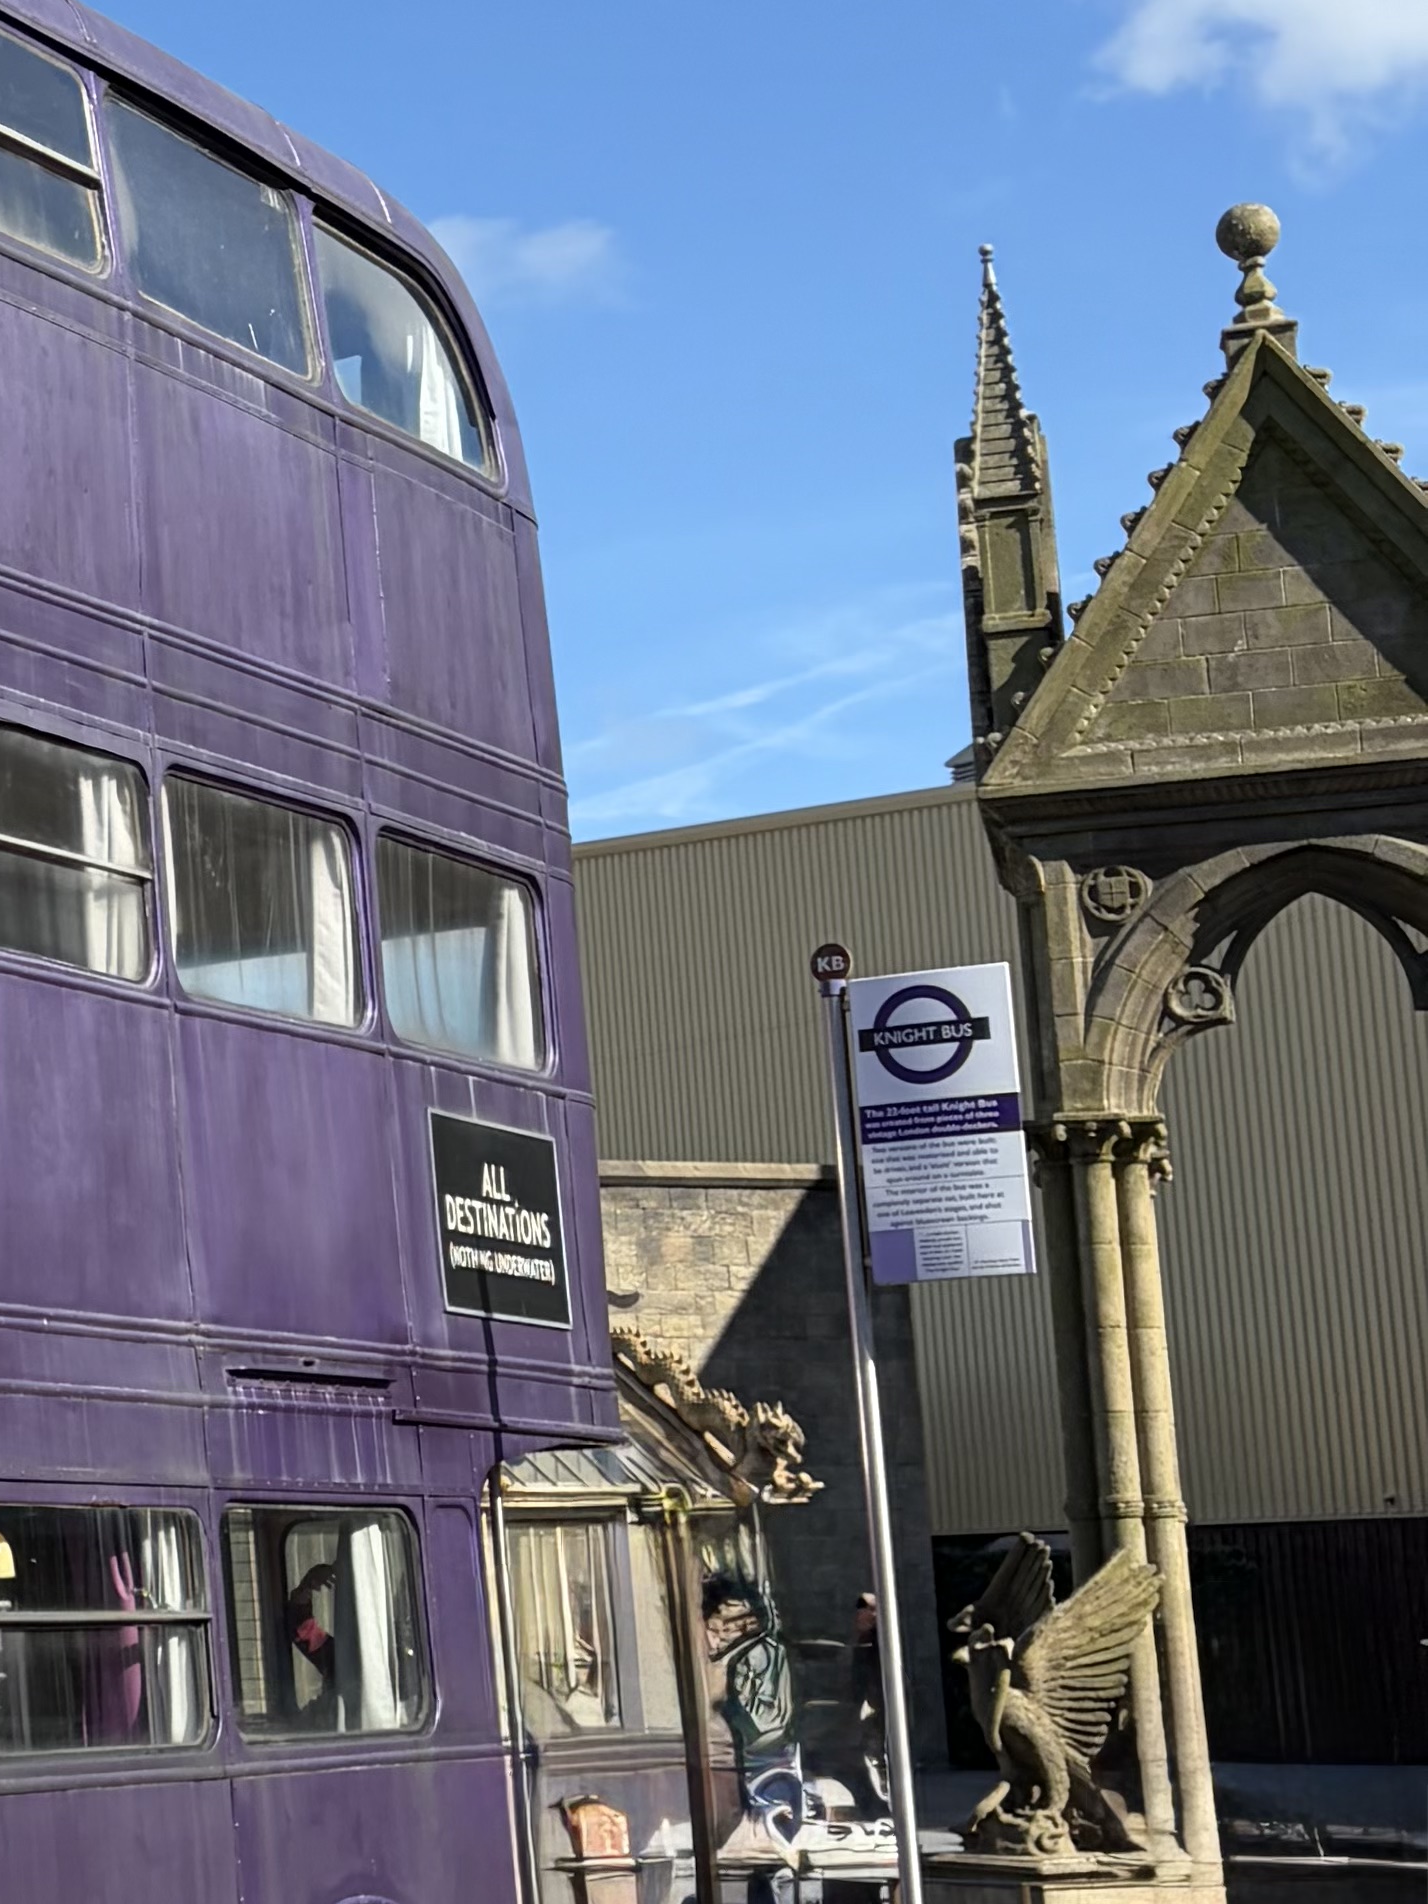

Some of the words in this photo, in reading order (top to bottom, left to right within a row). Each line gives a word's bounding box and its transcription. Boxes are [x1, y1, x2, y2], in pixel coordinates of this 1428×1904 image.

[817, 956, 844, 972] KB
[873, 1026, 937, 1046] KNIGHT
[941, 1023, 973, 1039] BUS
[866, 1110, 884, 1118] The
[923, 1104, 939, 1113] tall
[942, 1101, 976, 1113] Knight
[978, 1099, 998, 1108] Bus
[914, 1116, 935, 1124] from
[937, 1115, 963, 1123] pieces
[898, 1127, 930, 1136] London
[482, 1163, 511, 1202] ALL
